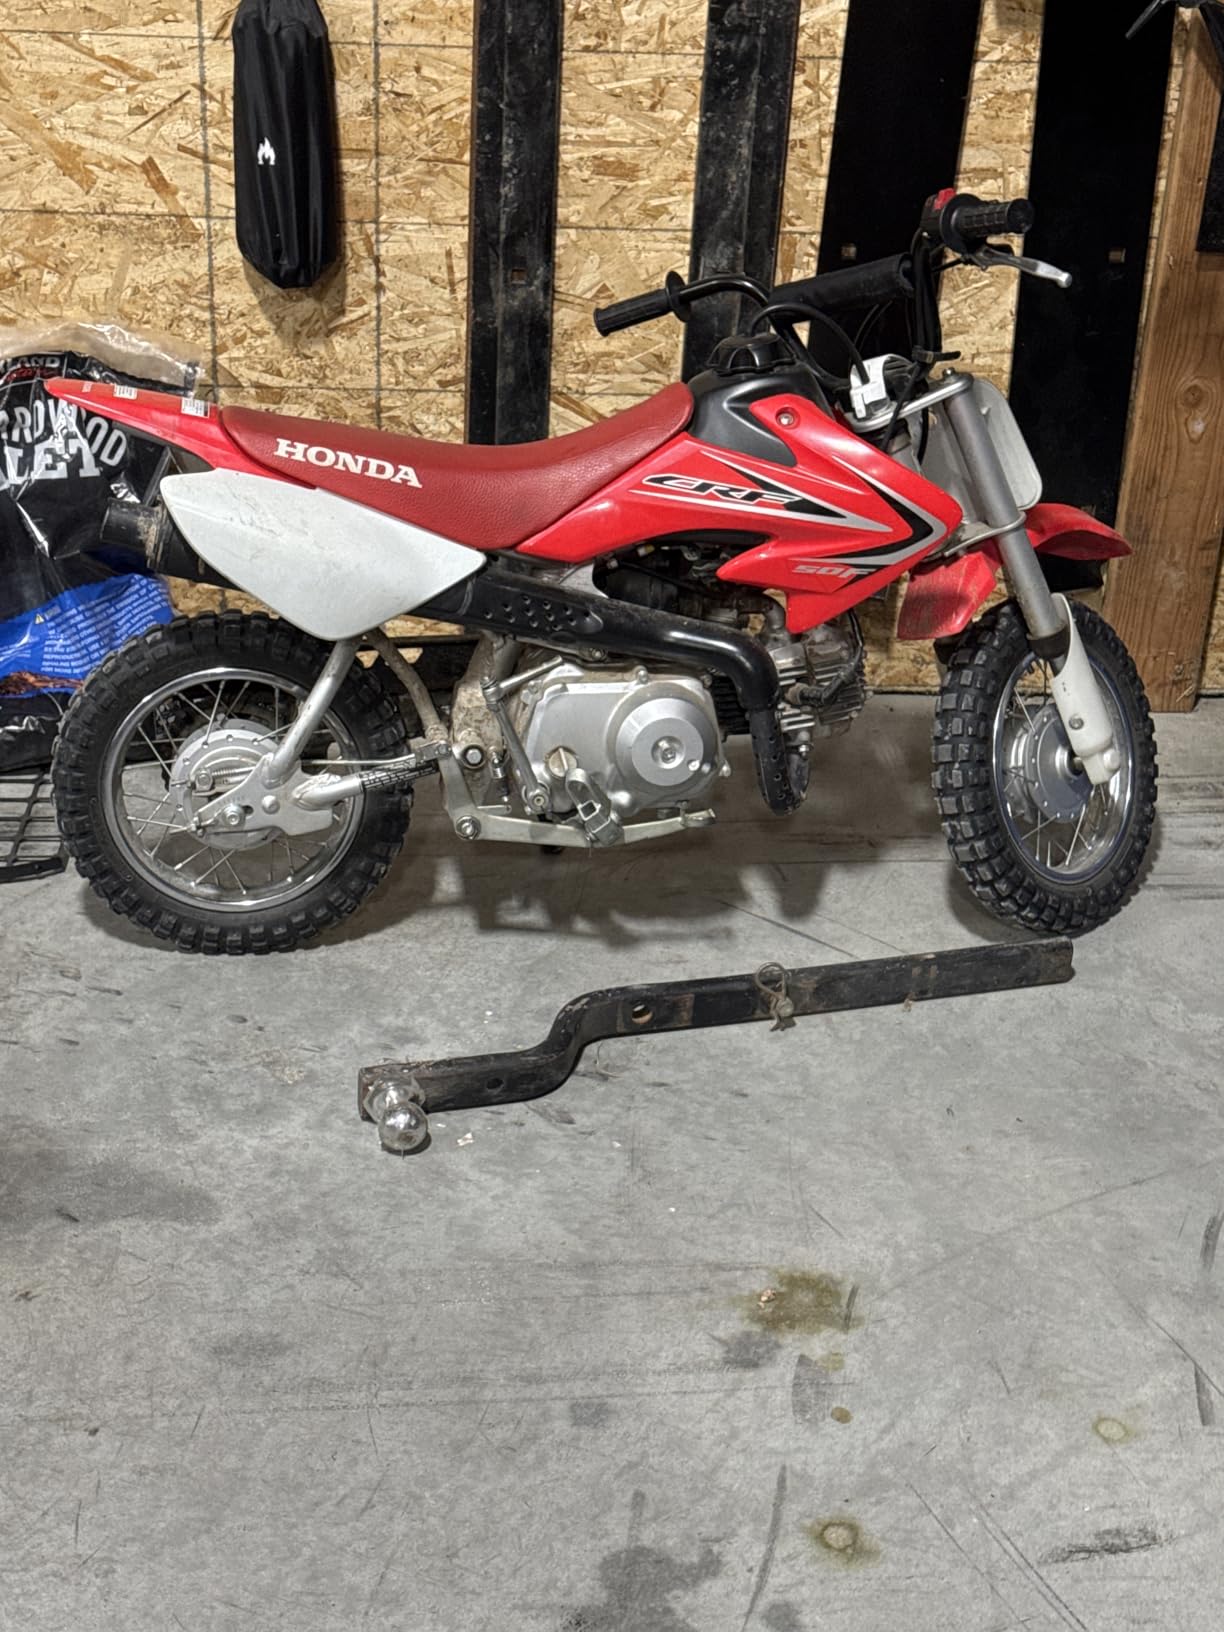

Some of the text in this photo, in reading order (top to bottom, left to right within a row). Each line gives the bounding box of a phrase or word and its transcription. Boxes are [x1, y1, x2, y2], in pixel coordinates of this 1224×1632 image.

[0, 398, 127, 467] RDWOD
[274, 438, 423, 488] HONDA
[642, 473, 803, 505] CRF
[792, 565, 877, 579] 50F
